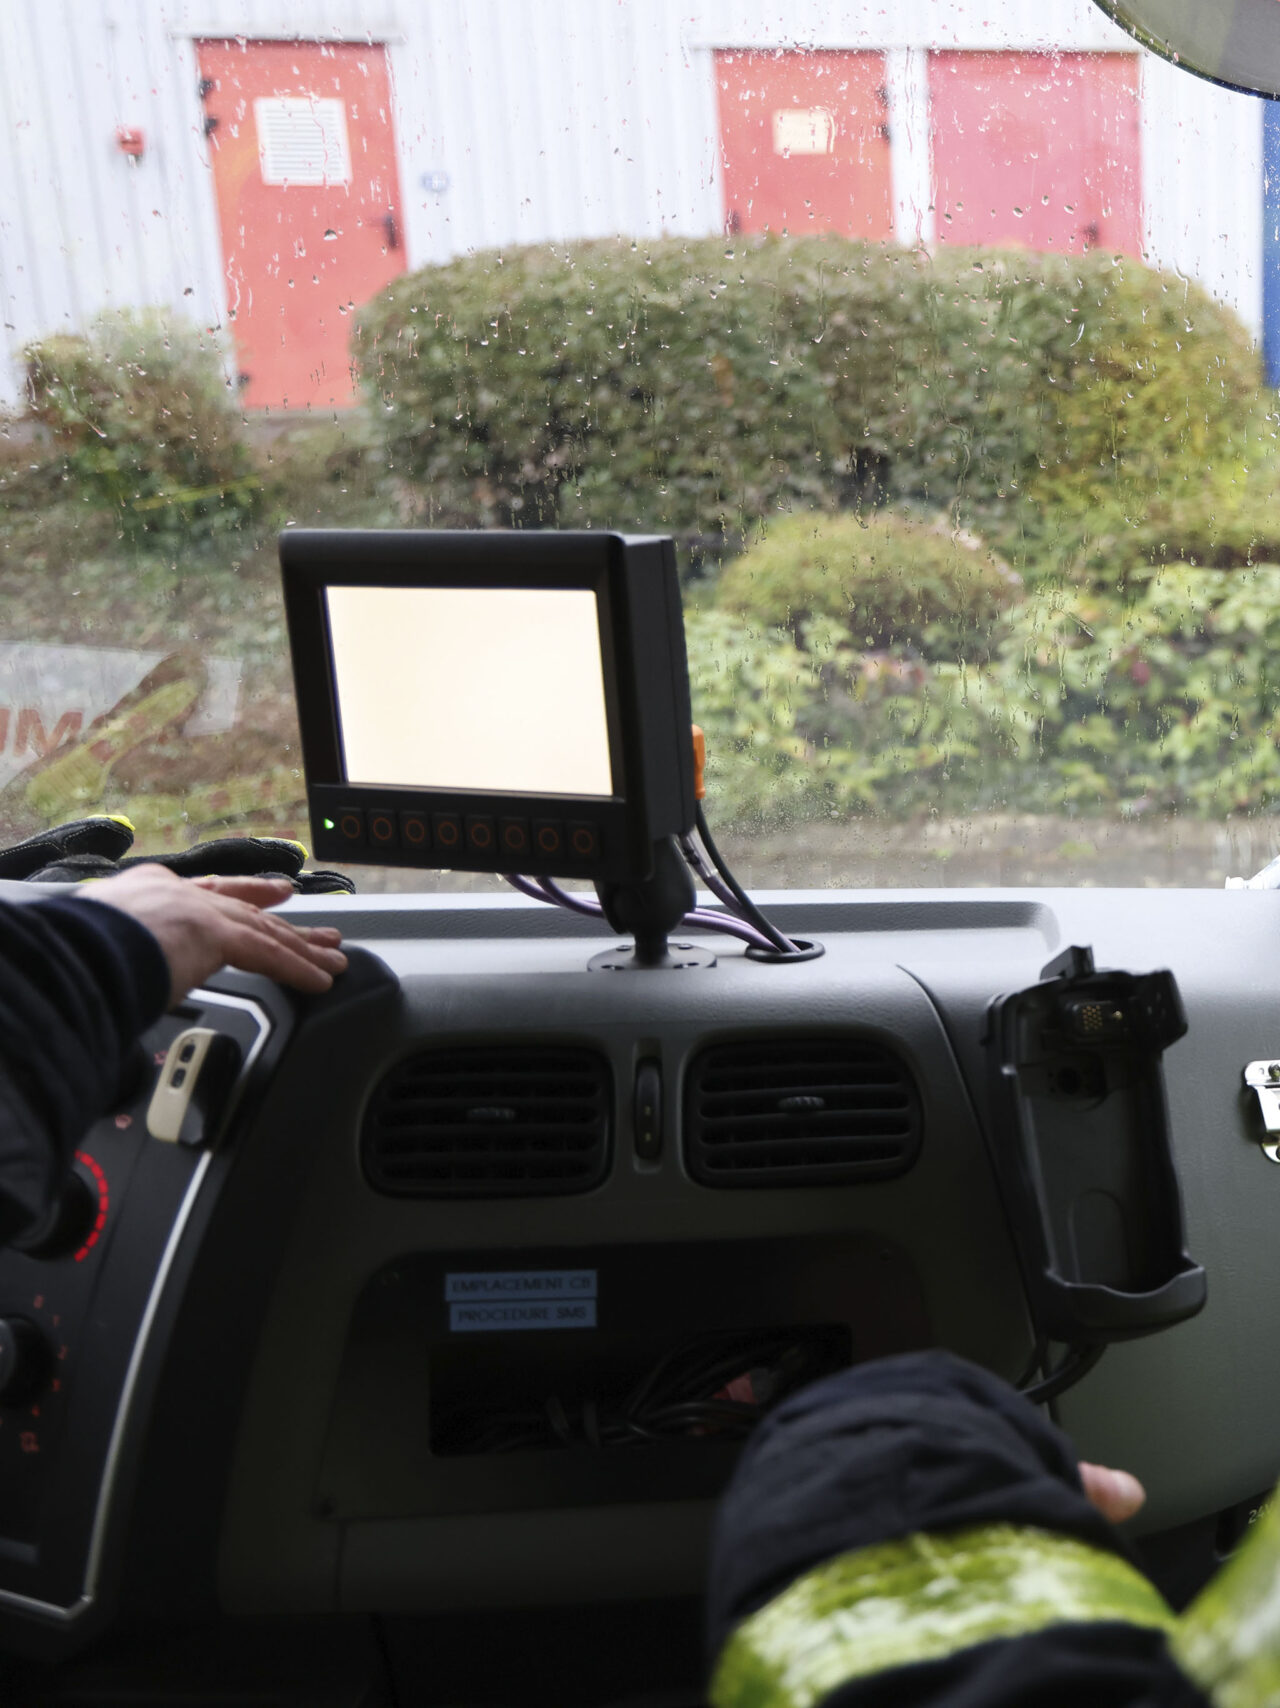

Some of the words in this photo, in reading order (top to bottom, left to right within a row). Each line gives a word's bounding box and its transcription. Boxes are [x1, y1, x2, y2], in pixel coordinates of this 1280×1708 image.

[452, 1276, 562, 1292] EMPLACEMENT
[458, 1307, 550, 1323] PROCEDURE
[556, 1305, 586, 1320] SMS
